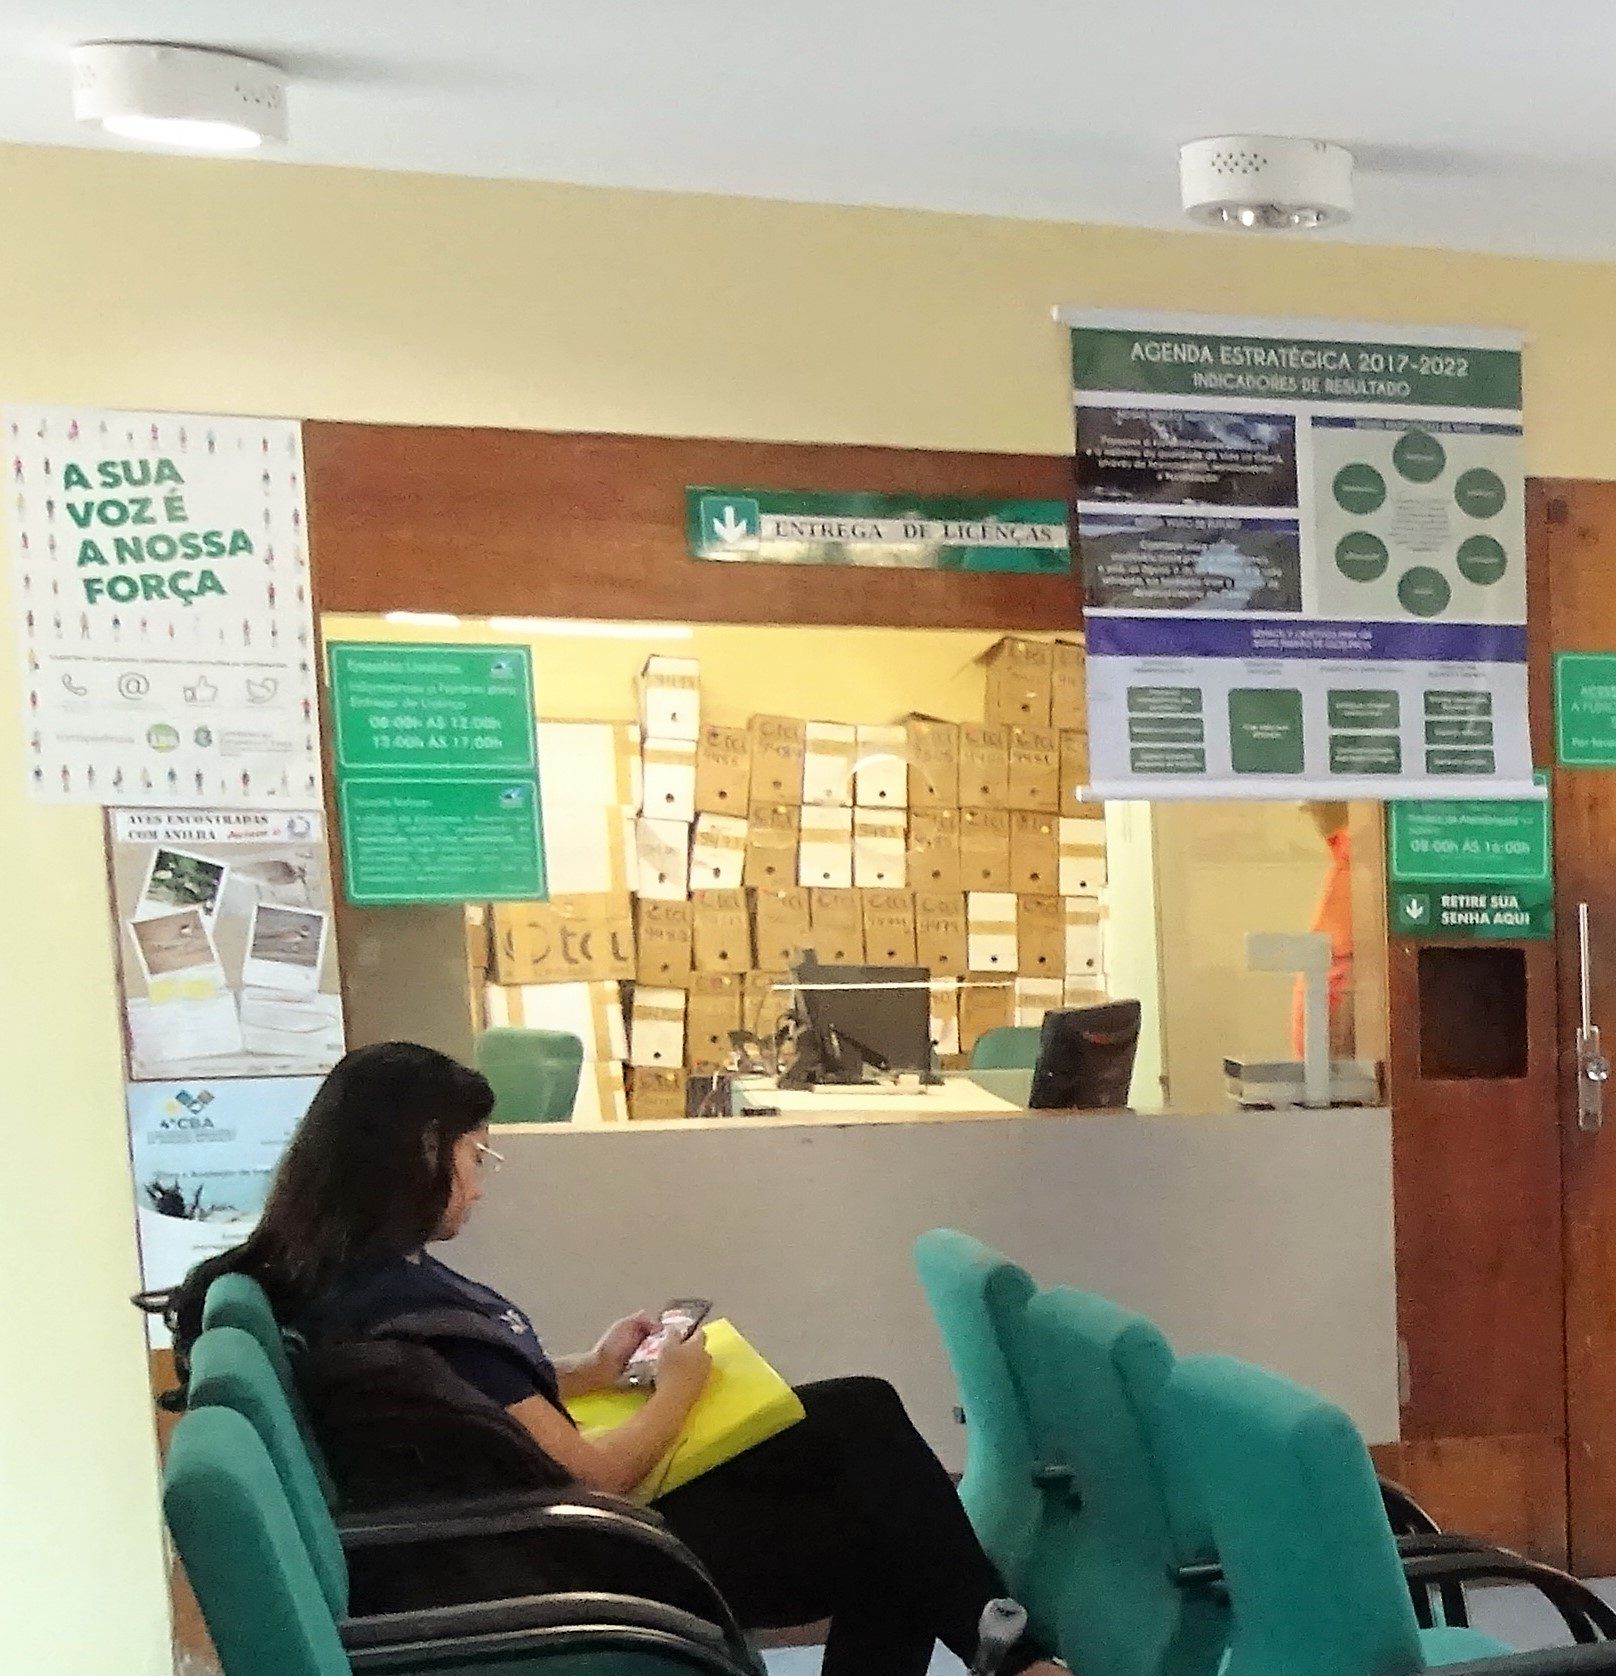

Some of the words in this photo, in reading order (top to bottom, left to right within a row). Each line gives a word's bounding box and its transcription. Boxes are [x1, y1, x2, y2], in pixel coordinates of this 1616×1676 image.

[1131, 341, 1214, 366] AGENDA
[1221, 344, 1351, 372] ESTRATÉGICA
[1358, 352, 1470, 378] 2017-2022
[1192, 372, 1298, 393] INDICADORES
[1302, 377, 1321, 394] DE
[1325, 379, 1411, 397] RESULTADO
[63, 462, 93, 491] A
[97, 457, 185, 489] SUA
[66, 497, 157, 529] VOZ
[163, 487, 189, 523] É
[77, 538, 110, 567] A
[113, 528, 254, 566] NOSSA
[775, 520, 884, 540] ENTREGA
[902, 523, 929, 540] DE
[943, 523, 1053, 545] LICENÇAS
[83, 569, 228, 607] FORÇA
[1441, 895, 1487, 909] RETIRE
[1490, 896, 1519, 909] SUA
[1441, 912, 1490, 925] SENHA
[1493, 912, 1530, 925] AQUI
